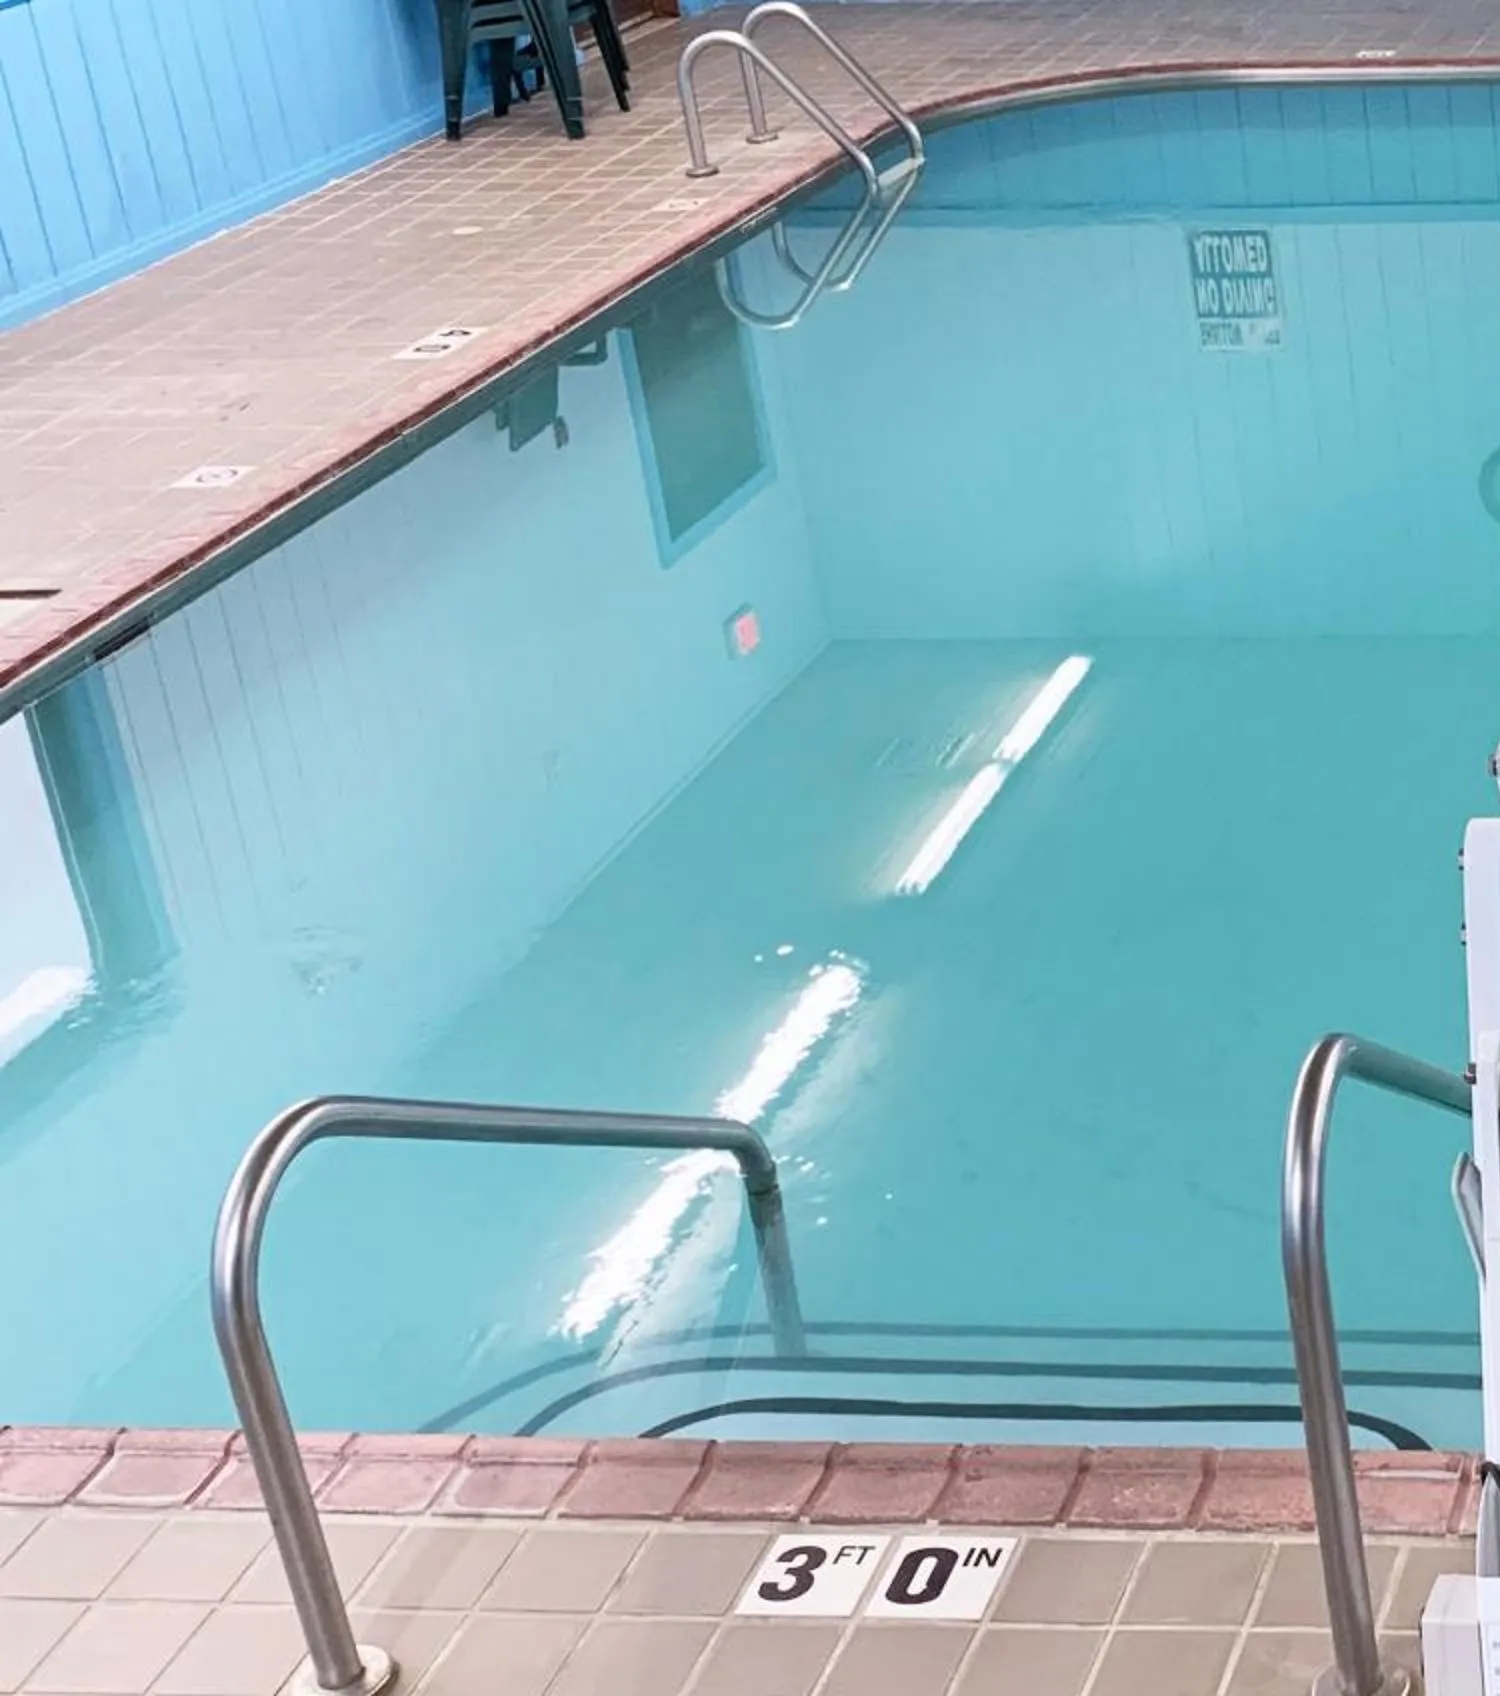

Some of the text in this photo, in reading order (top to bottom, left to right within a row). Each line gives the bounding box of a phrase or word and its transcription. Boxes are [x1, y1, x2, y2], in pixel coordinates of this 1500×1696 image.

[757, 1545, 1003, 1605] 3 FT 0 IN
